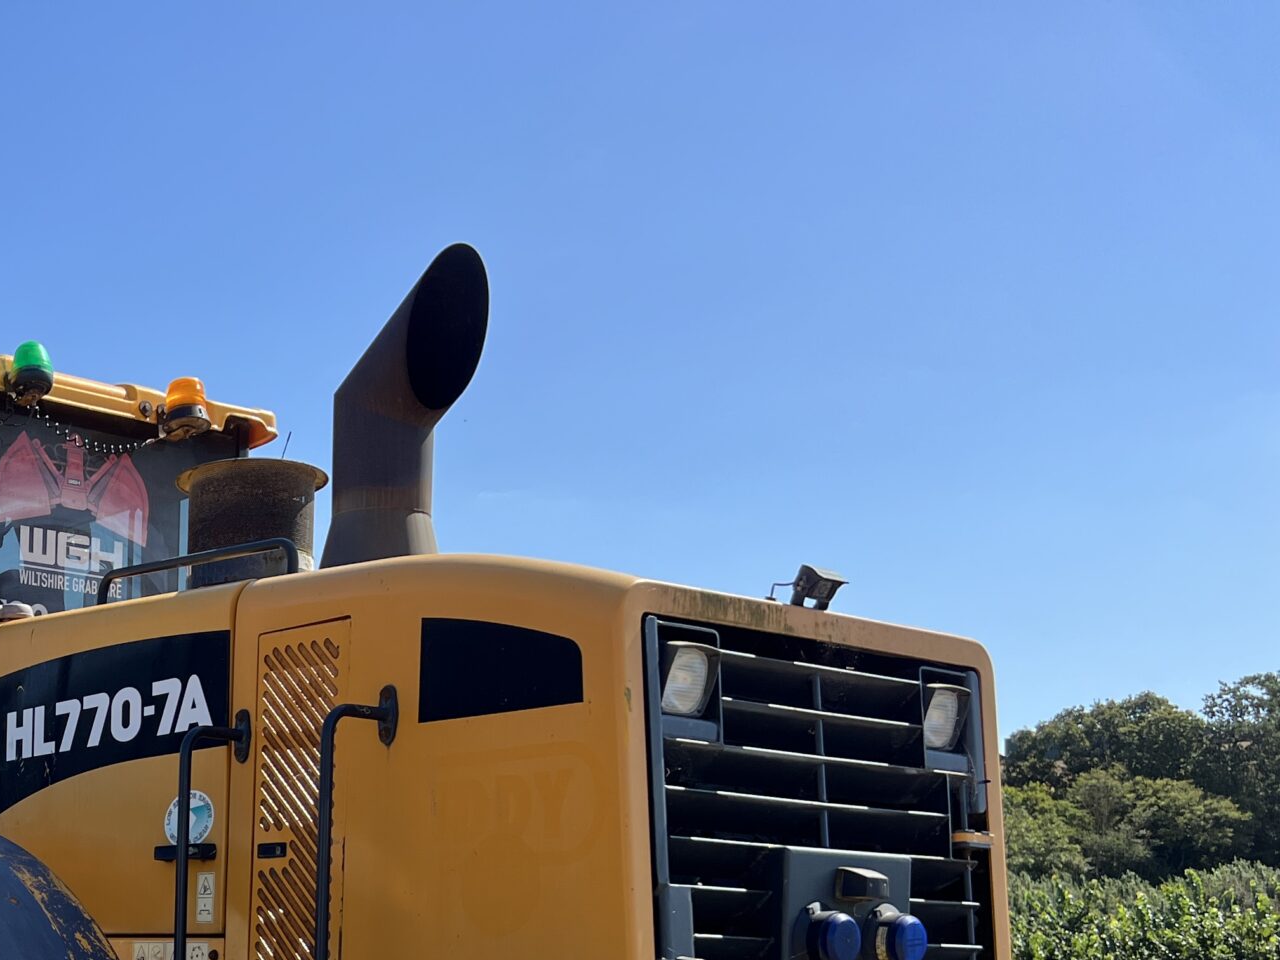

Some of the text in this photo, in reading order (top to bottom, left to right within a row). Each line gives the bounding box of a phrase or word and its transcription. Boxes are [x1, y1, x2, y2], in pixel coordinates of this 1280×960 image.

[19, 524, 124, 573] WGH
[19, 569, 70, 591] WILTSHIRE
[72, 578, 98, 595] GRAB
[6, 673, 214, 763] HL770-7A
